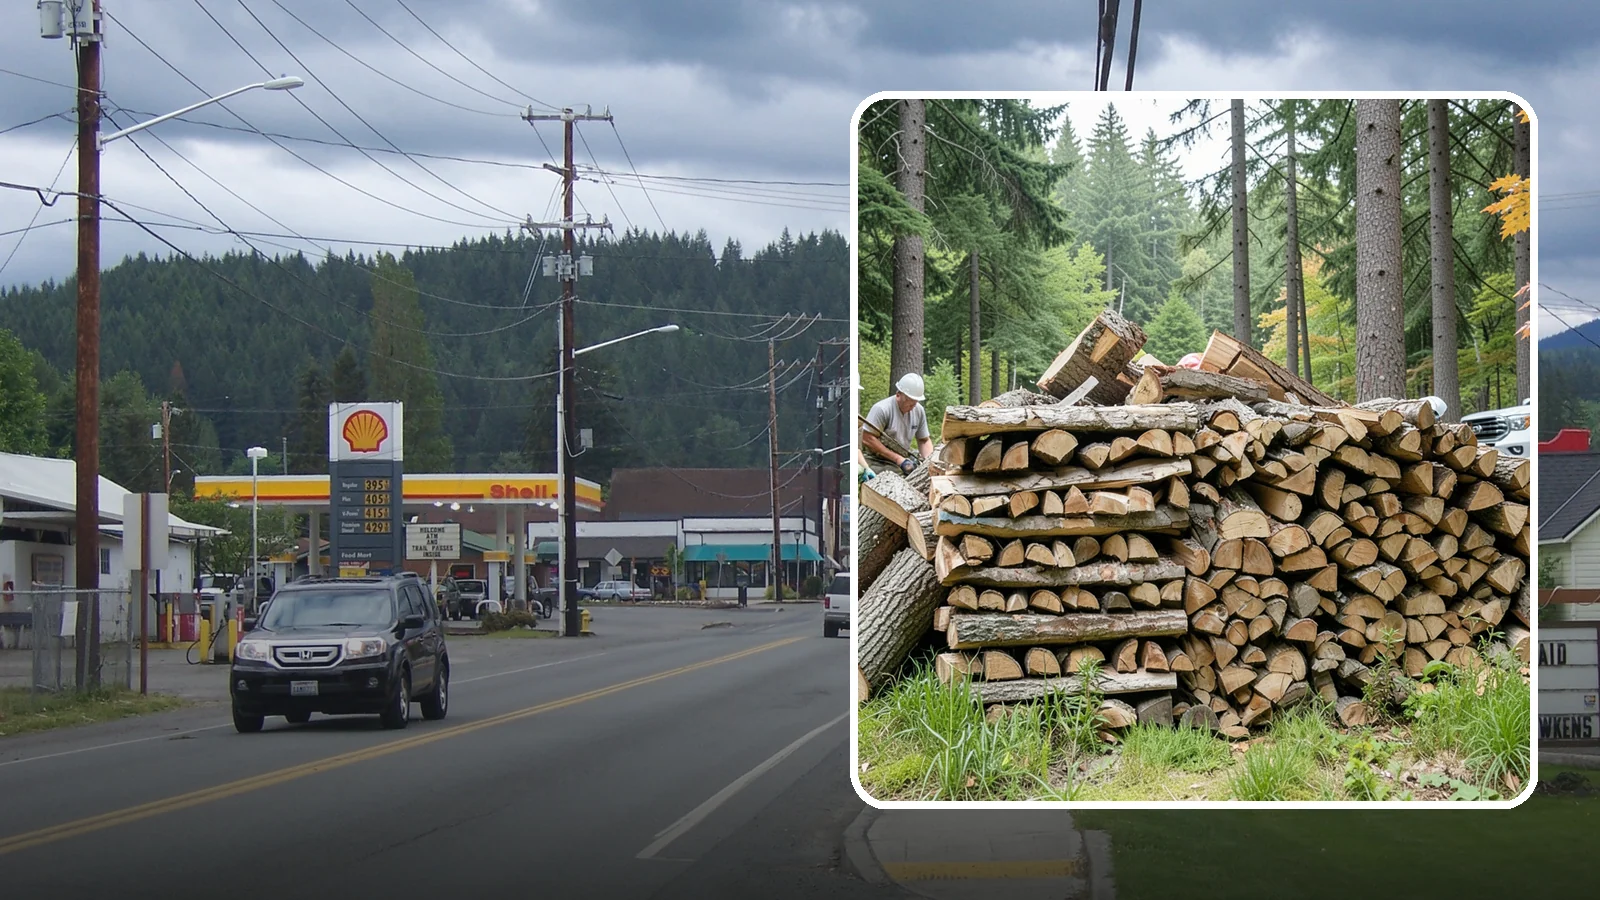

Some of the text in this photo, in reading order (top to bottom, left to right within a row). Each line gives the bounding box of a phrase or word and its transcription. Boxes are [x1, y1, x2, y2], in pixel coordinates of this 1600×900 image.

[365, 480, 384, 490] 395
[490, 484, 547, 499] Shell
[365, 494, 384, 504] 405
[365, 508, 384, 518] 415
[365, 522, 384, 532] 429
